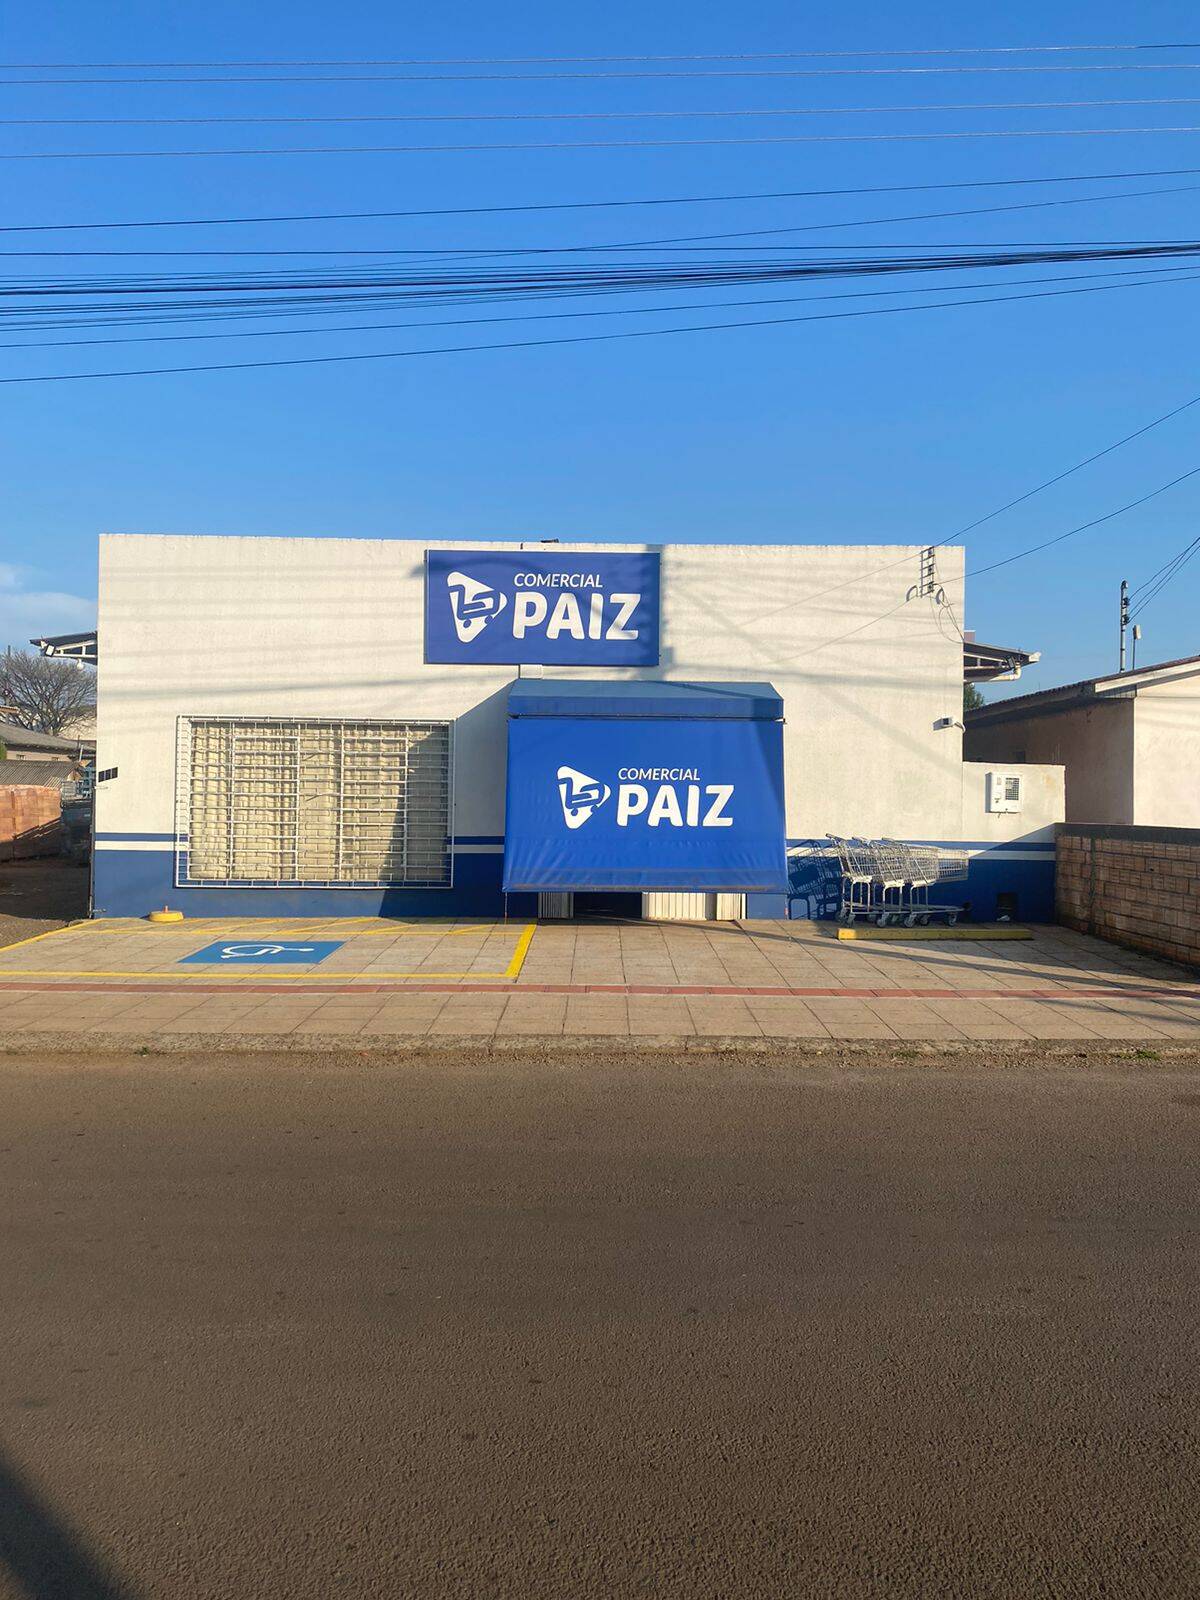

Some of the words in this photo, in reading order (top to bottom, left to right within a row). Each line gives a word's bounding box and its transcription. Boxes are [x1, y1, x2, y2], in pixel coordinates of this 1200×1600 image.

[513, 573, 603, 588] COMERCIAL
[512, 592, 641, 641] PAIZ
[618, 767, 701, 781] COMERCIAL
[616, 784, 735, 827] PAIZ
